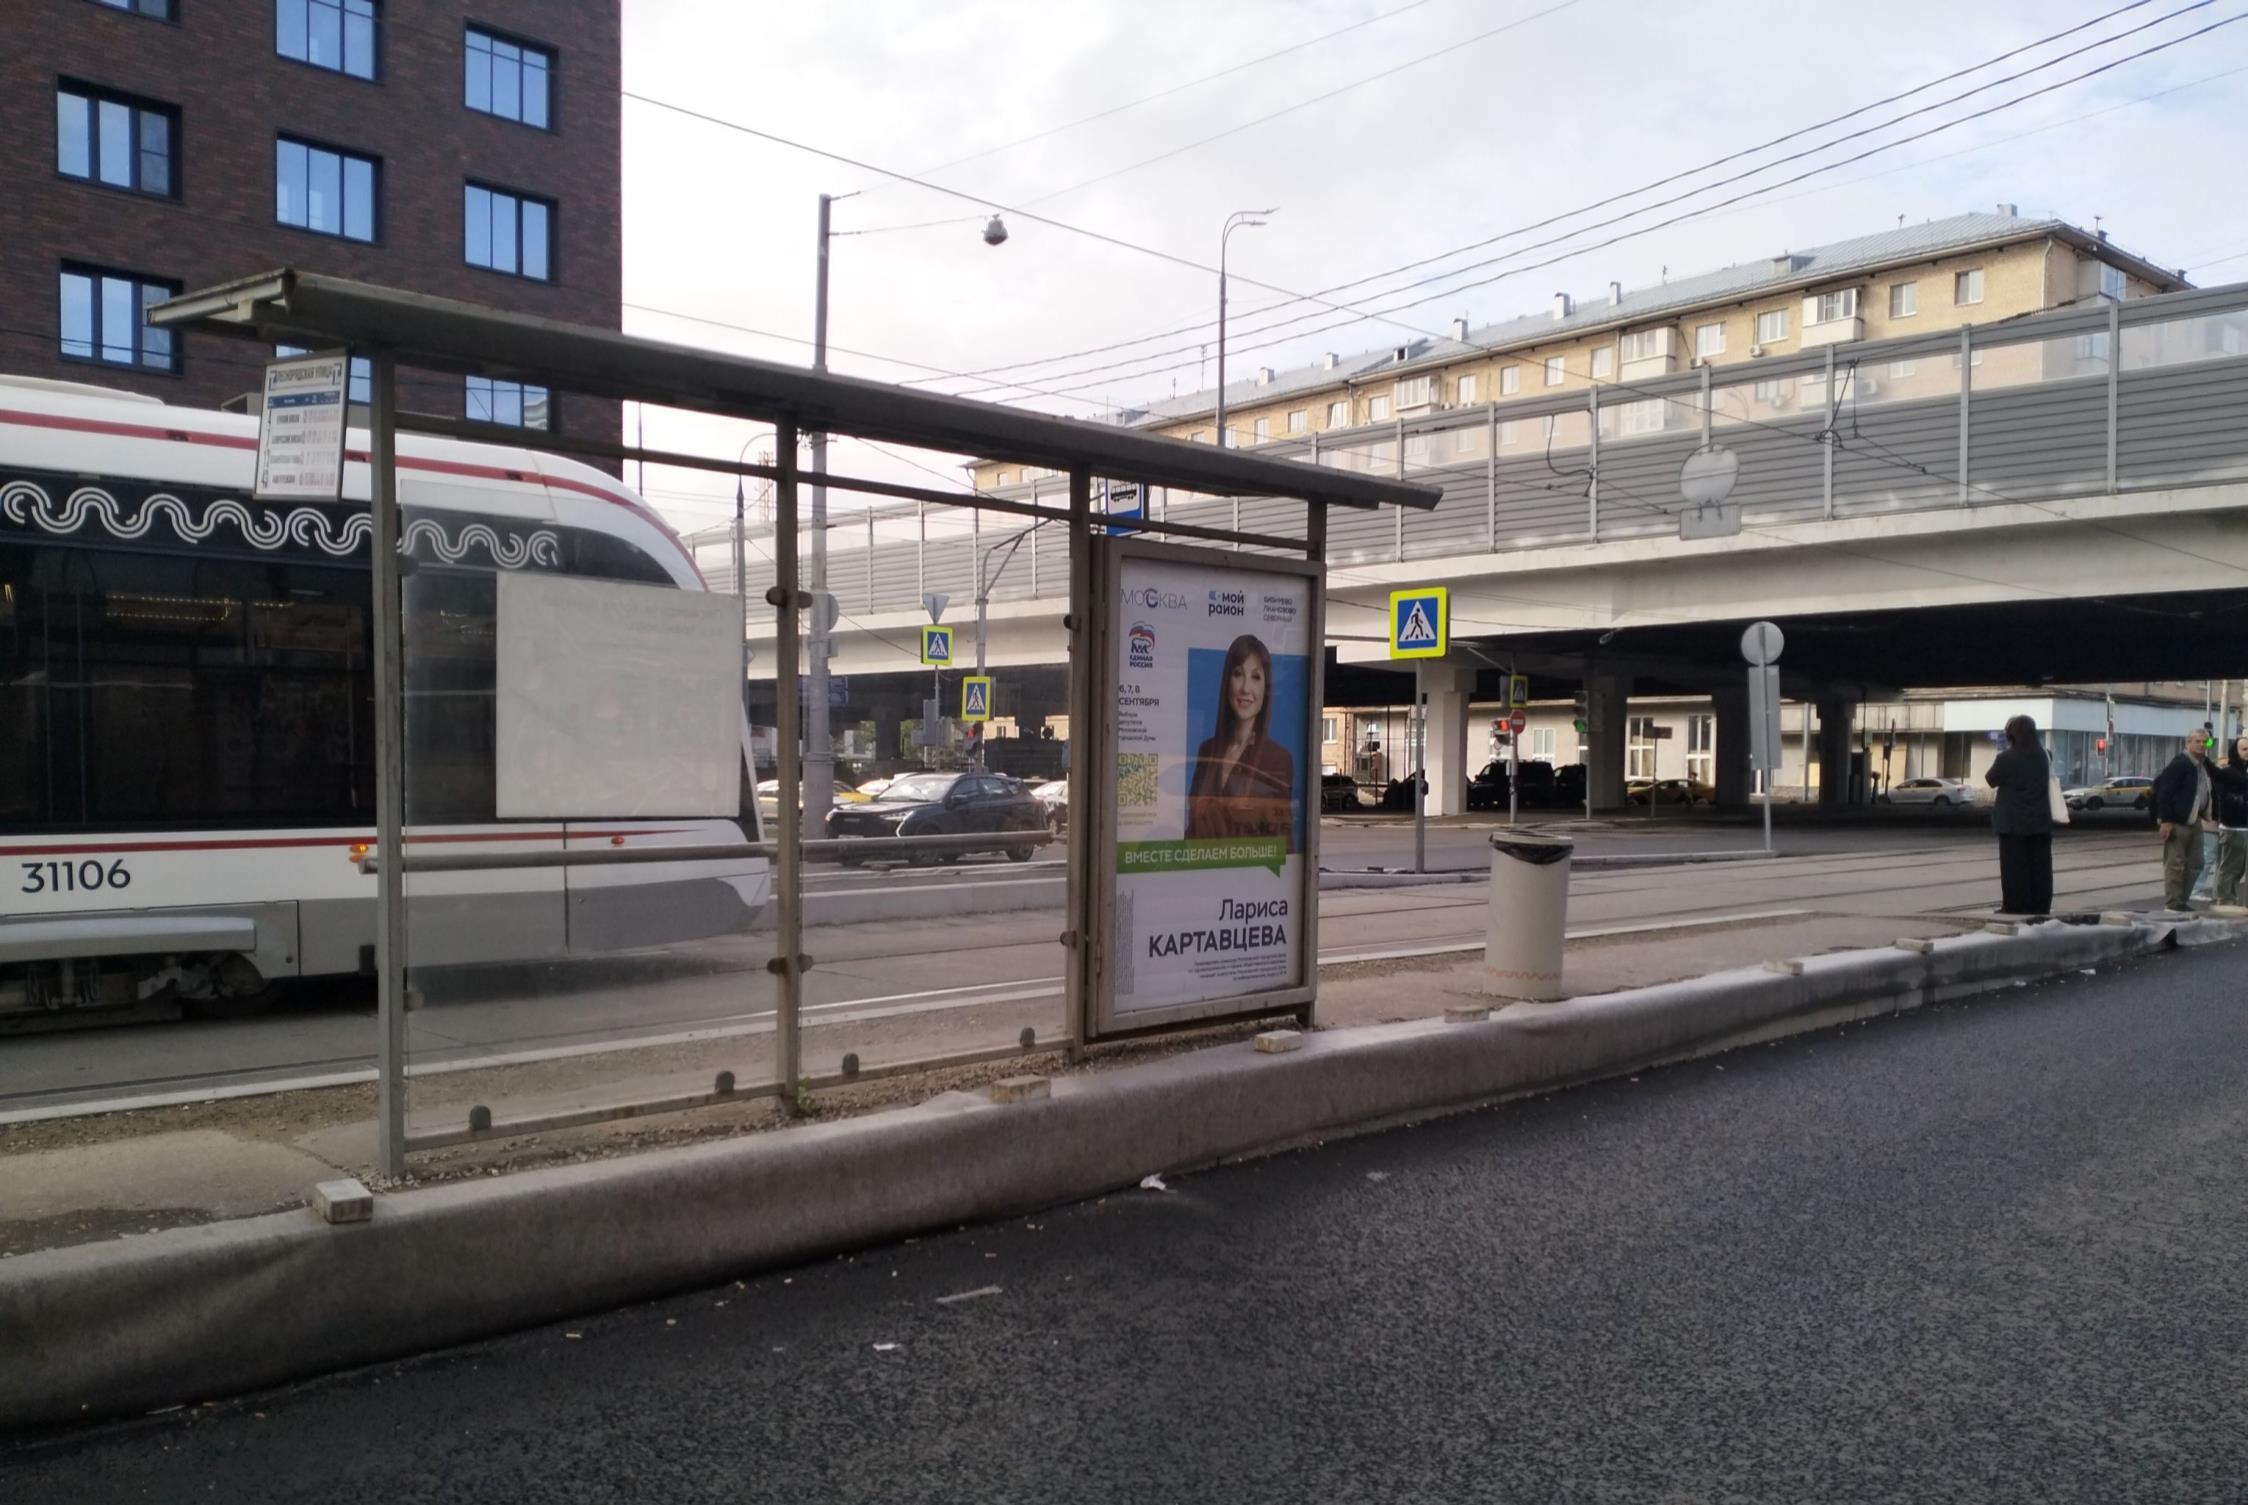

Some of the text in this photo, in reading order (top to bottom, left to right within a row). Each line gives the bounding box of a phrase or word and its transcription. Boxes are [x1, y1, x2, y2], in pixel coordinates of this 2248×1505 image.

[1120, 588, 1187, 610] МОСКВА
[1222, 590, 1244, 604] мой
[1129, 654, 1153, 662] ЕДИНАЯ
[1129, 661, 1153, 669] РОССИЯ
[1119, 697, 1160, 707] СЕНТЯБРЯ
[1125, 845, 1277, 865] ВМЕСТЕ СДЕЛАЕМ БОЛЬШЕ!
[21, 858, 131, 893] 31106
[1218, 898, 1289, 924] Лариса
[1149, 924, 1287, 958] КАРТАВЦЕВА
